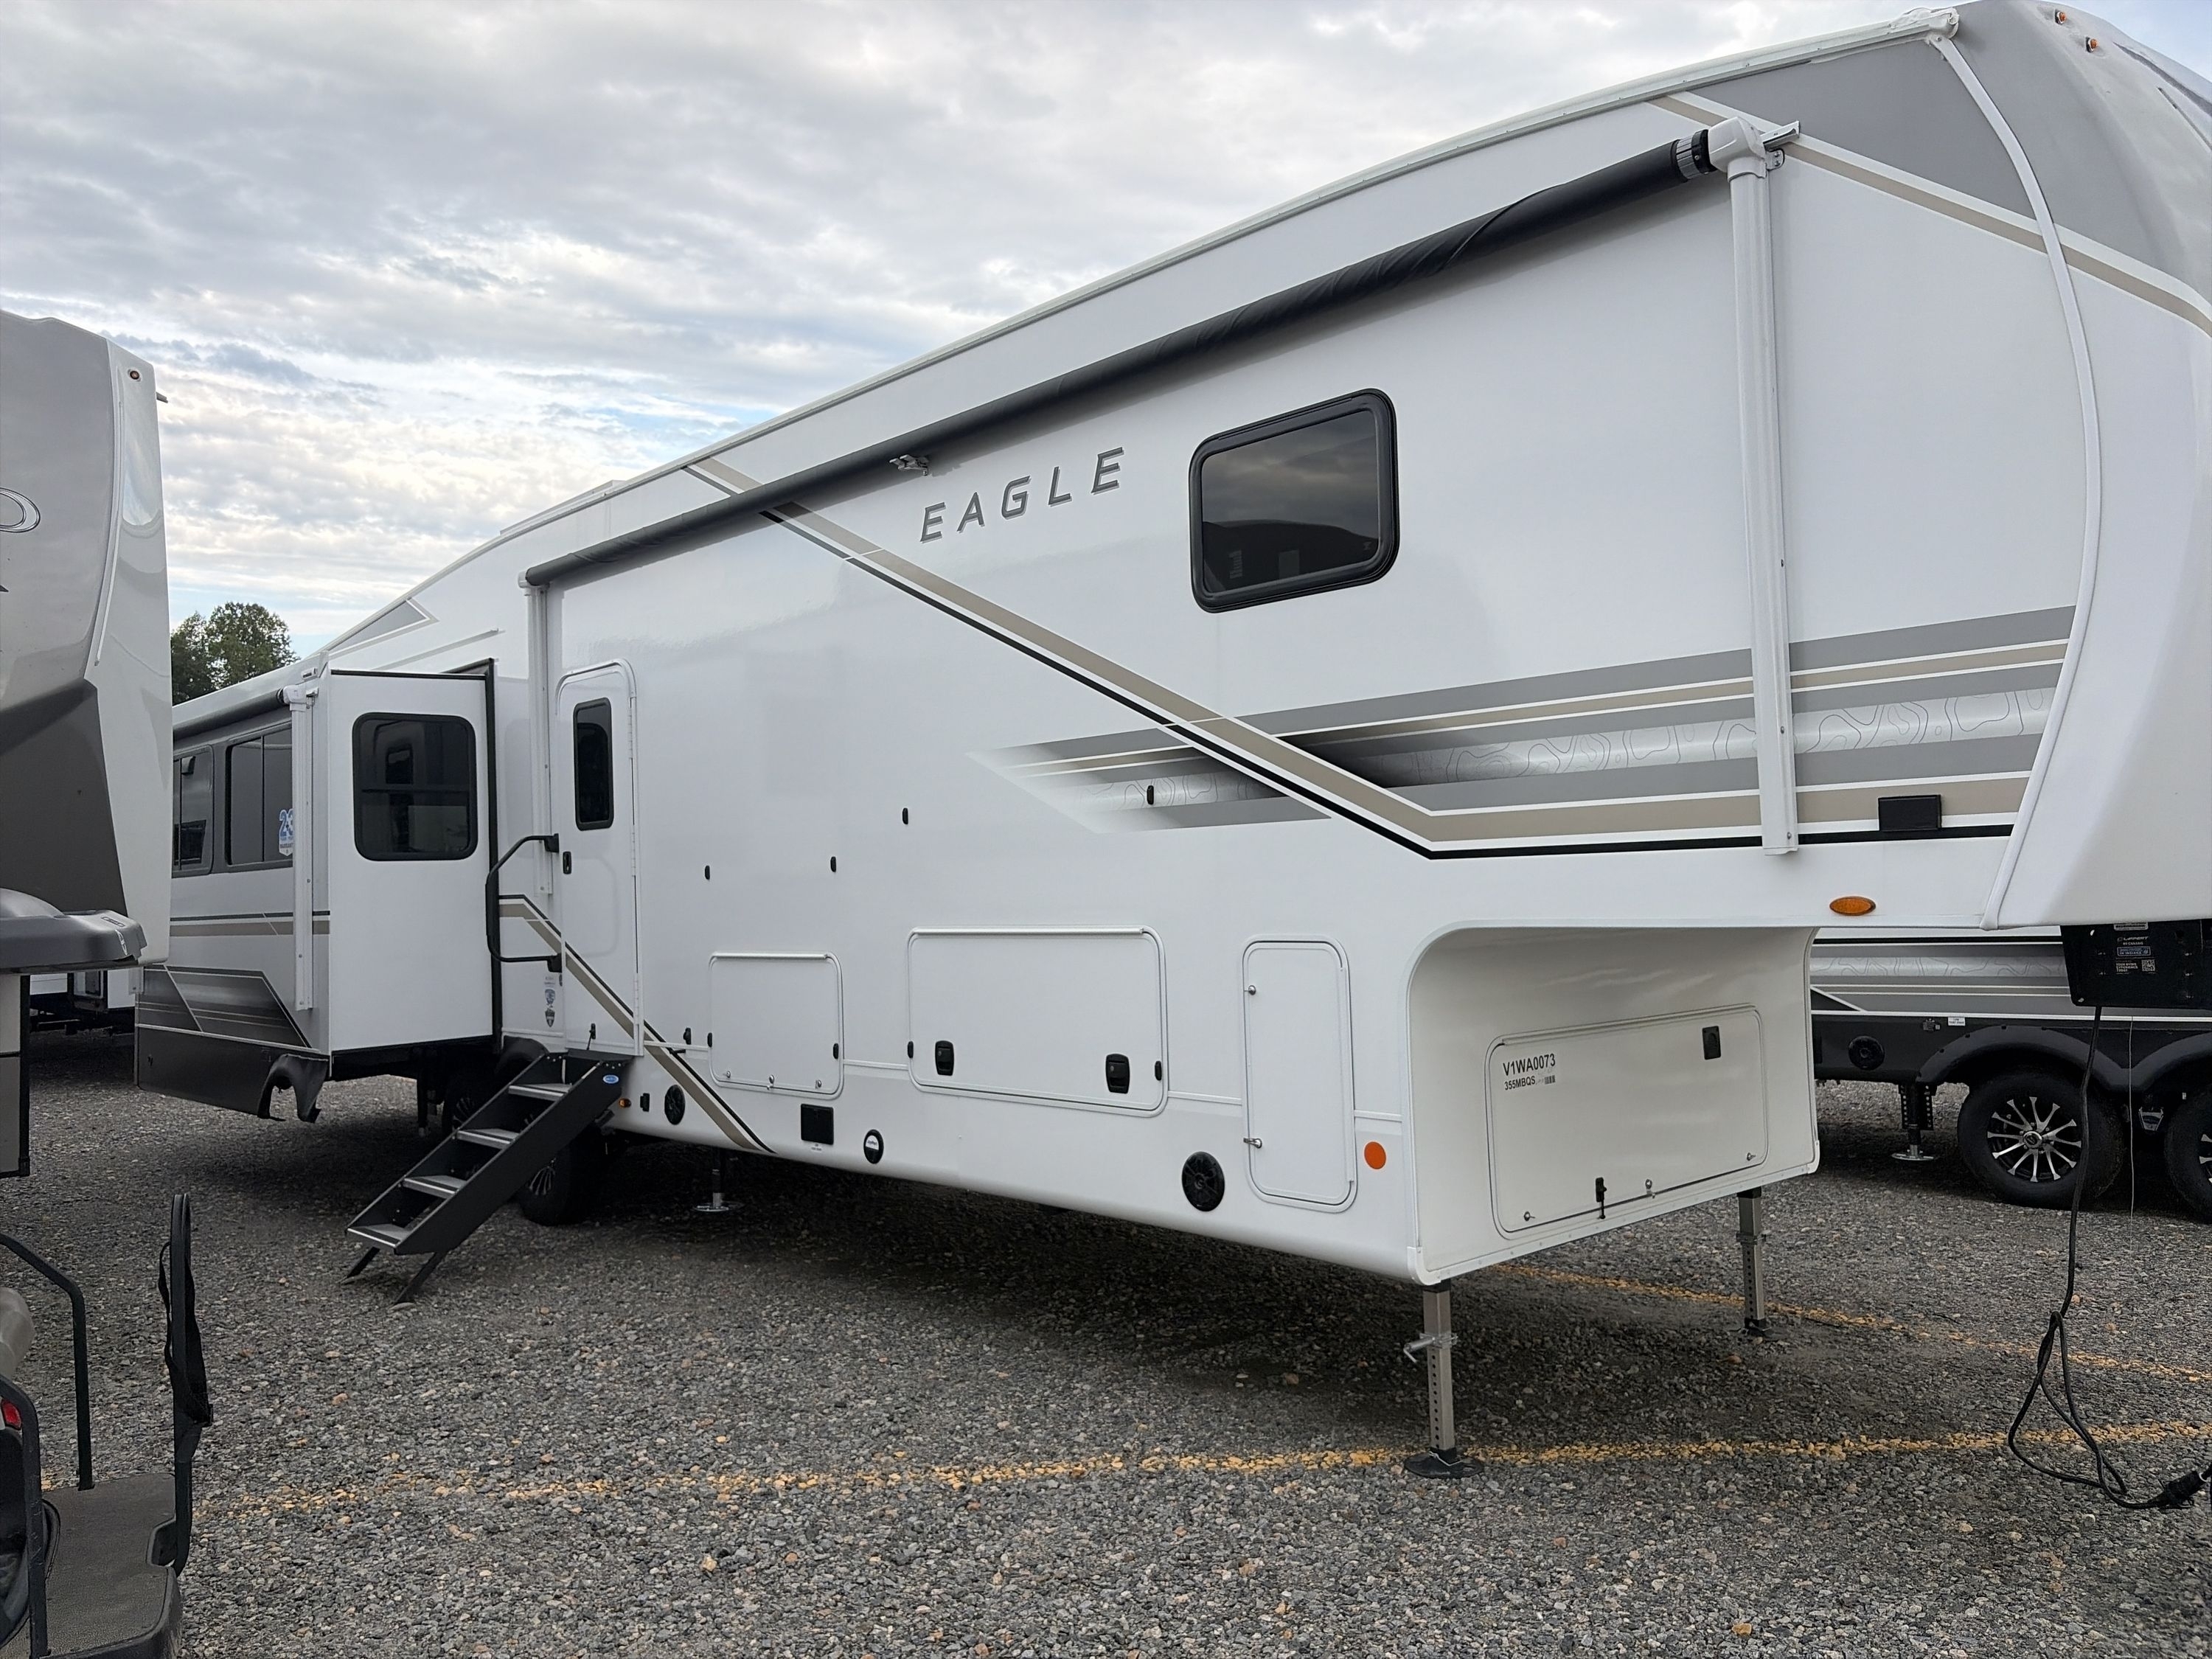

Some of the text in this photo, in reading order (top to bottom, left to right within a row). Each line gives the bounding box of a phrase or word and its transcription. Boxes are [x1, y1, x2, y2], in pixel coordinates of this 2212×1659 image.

[920, 447, 1124, 543] EAGLE
[1503, 1053, 1556, 1076] V1WA0073
[1504, 1075, 1536, 1091] 355MBQS
